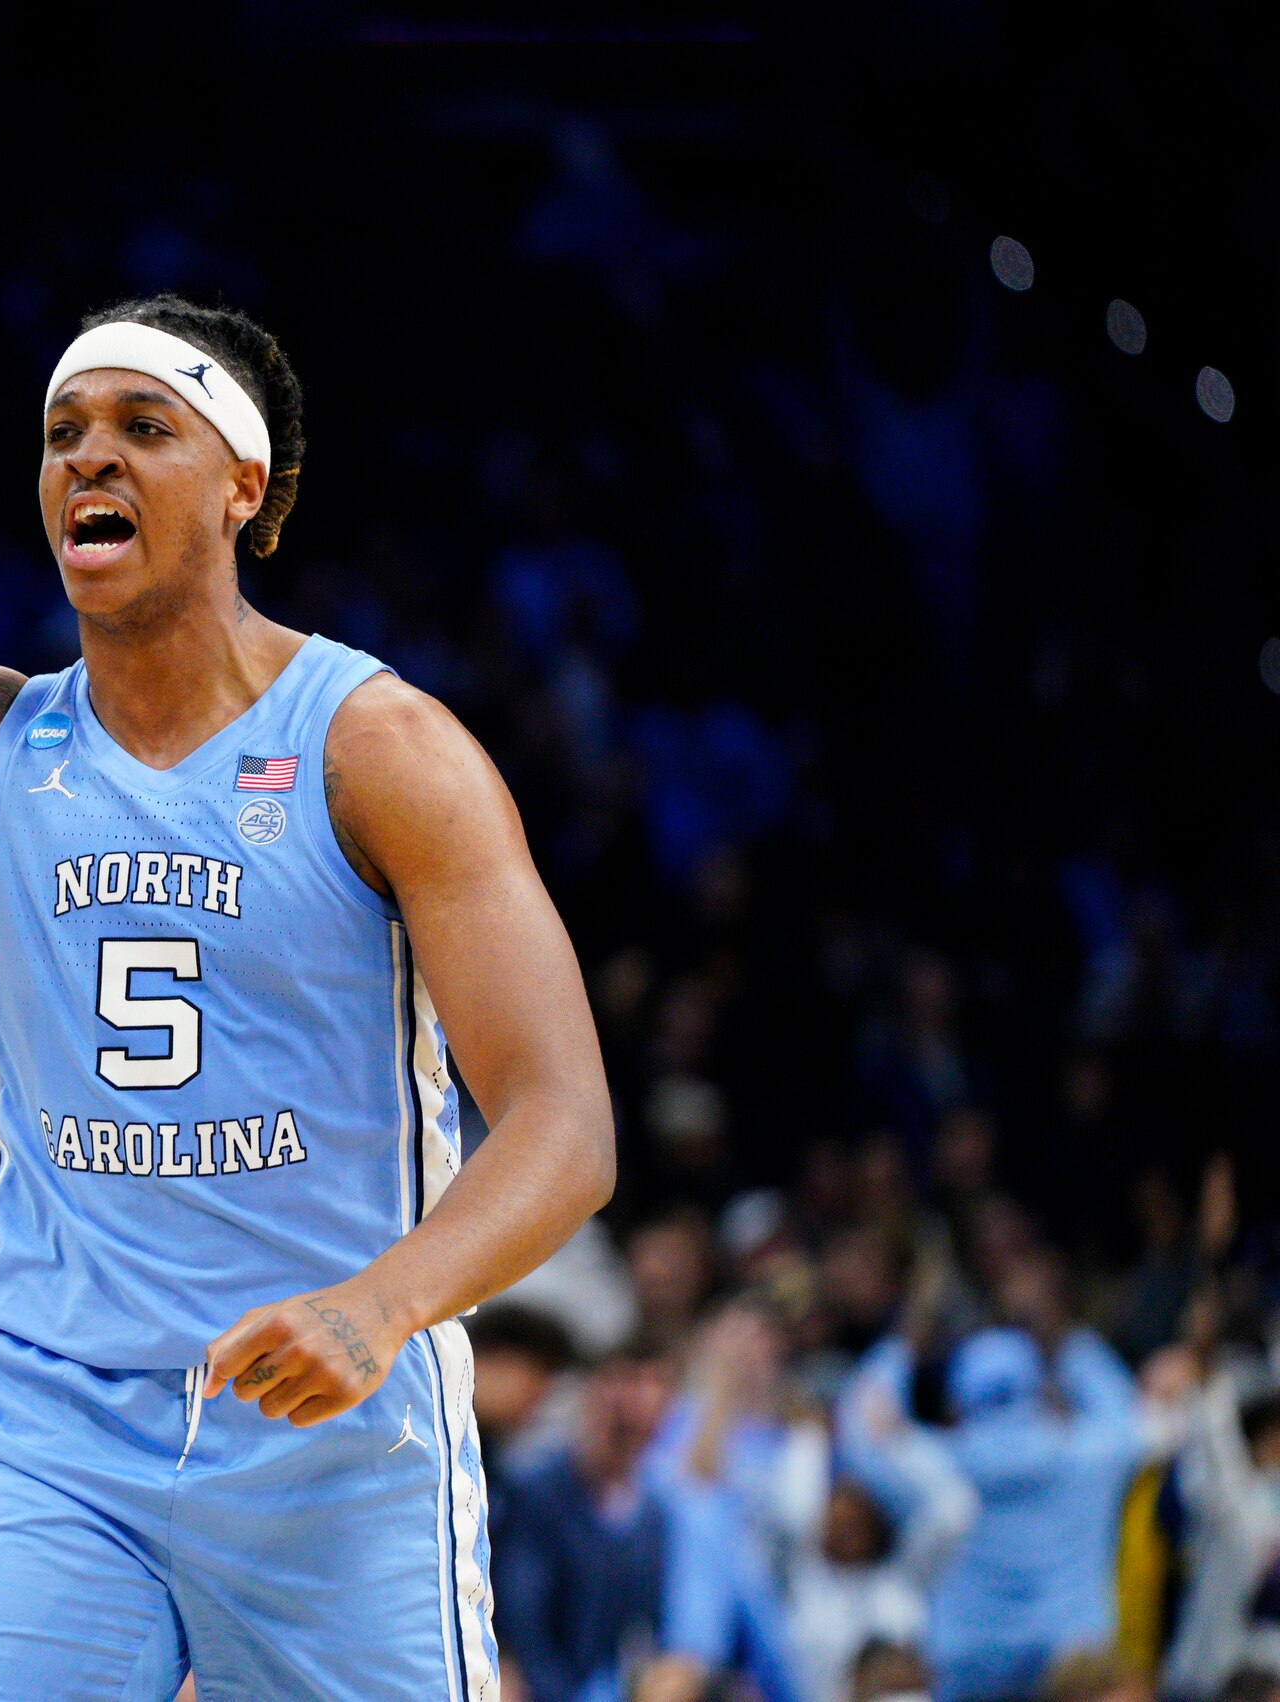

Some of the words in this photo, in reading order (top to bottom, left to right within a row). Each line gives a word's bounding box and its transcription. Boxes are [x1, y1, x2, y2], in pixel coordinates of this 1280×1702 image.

[31, 728, 68, 740] NCAA
[245, 813, 282, 827] ACC
[55, 852, 243, 918] NORTH
[96, 937, 202, 1090] 5
[39, 1108, 307, 1177] CAROLINA
[304, 1295, 380, 1382] LOSER
